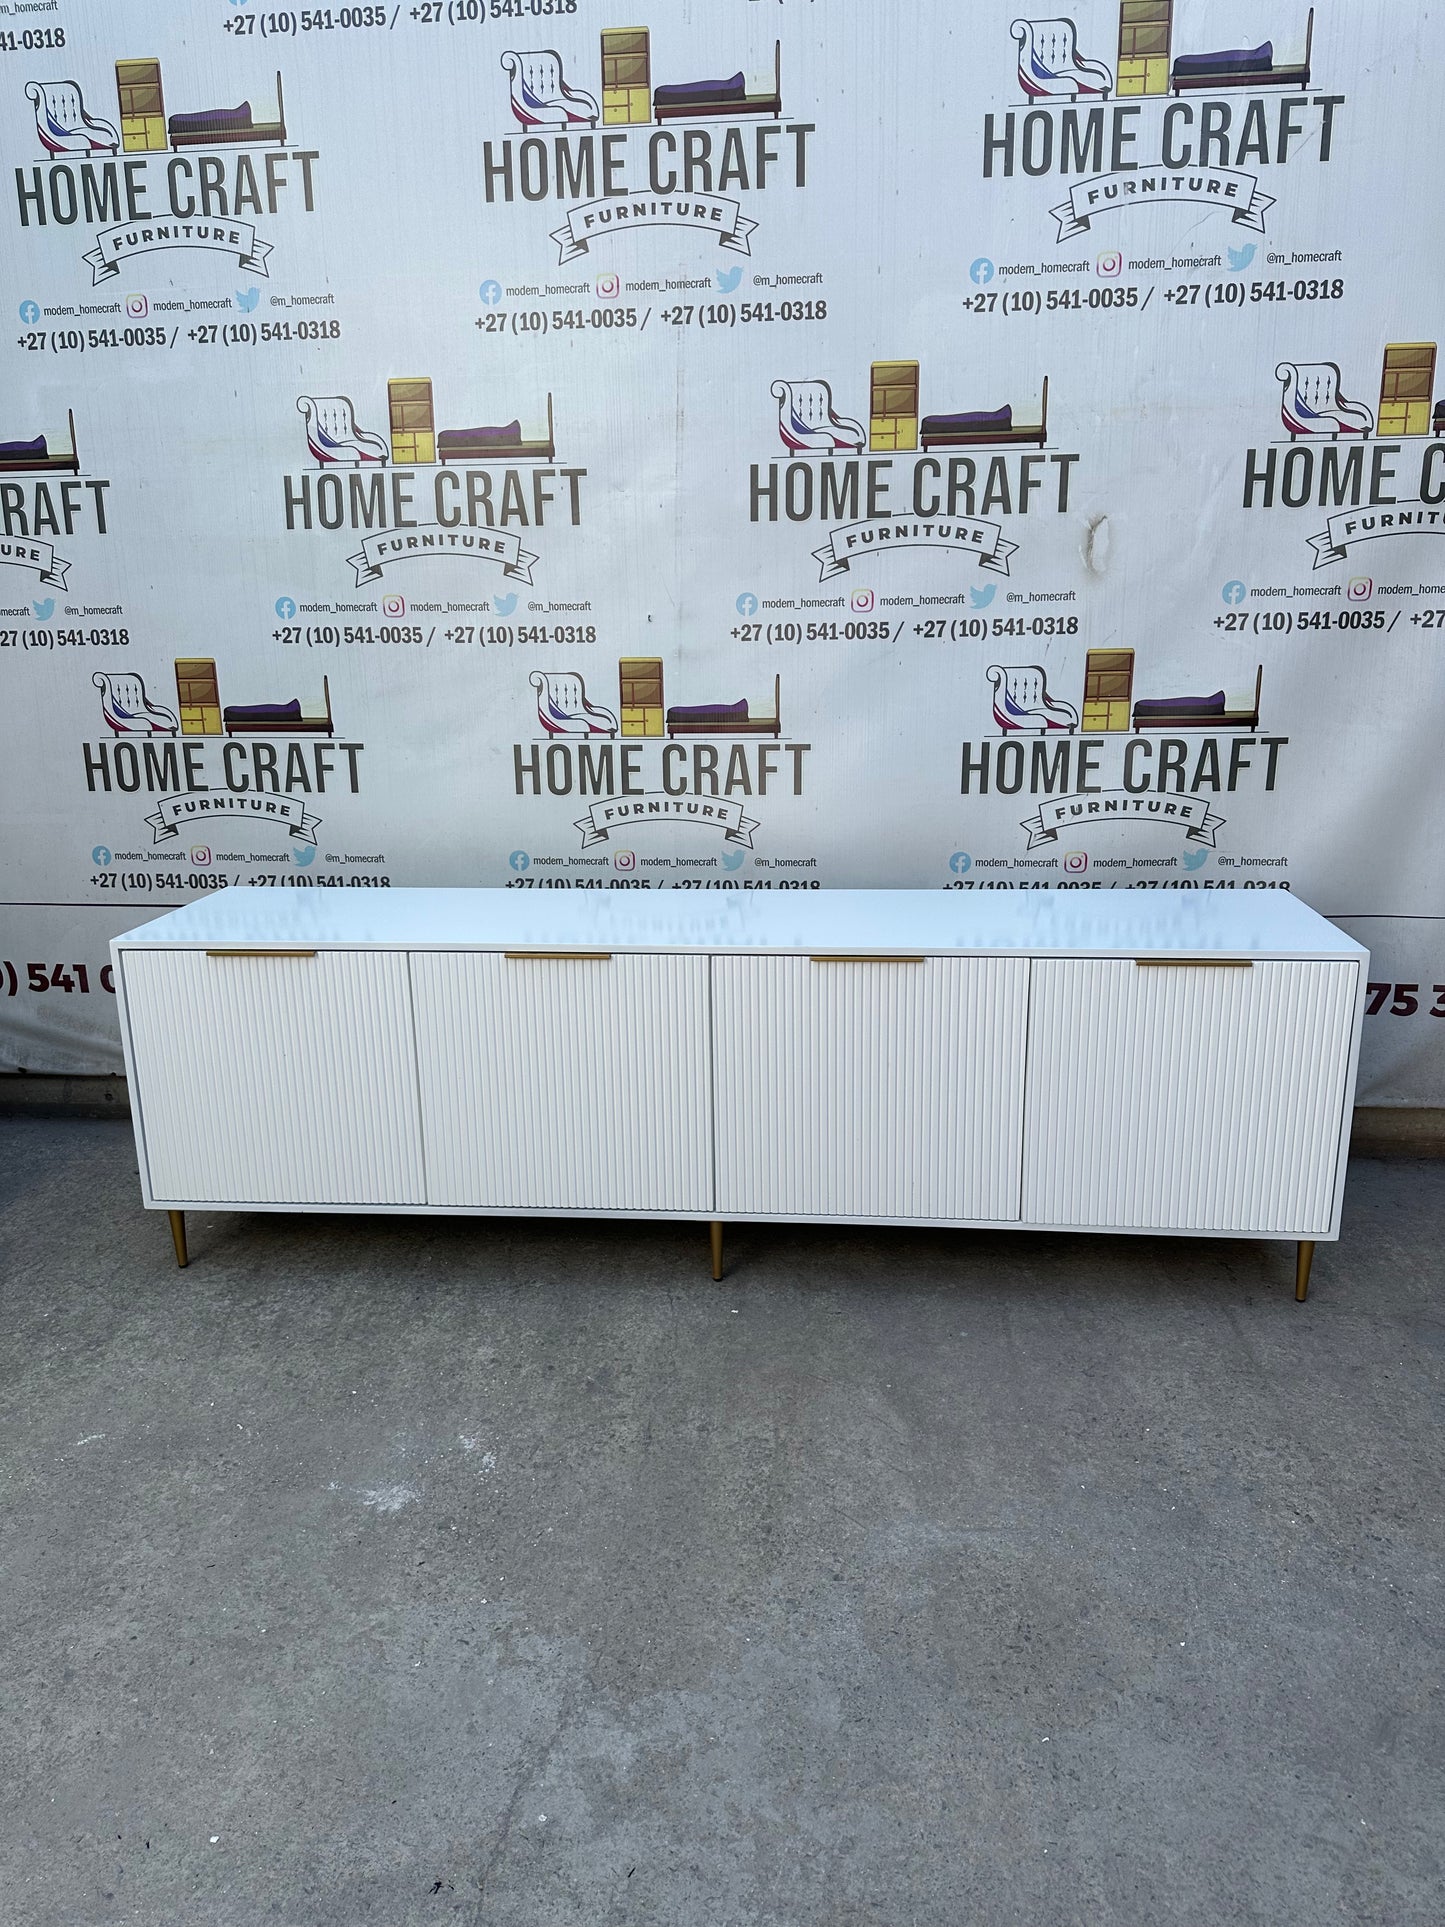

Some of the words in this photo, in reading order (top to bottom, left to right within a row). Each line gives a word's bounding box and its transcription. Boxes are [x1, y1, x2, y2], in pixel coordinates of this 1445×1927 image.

[0, 0, 58, 16] m_homecraft
[223, 14, 256, 35] +27
[260, 11, 297, 38] (10)
[301, 5, 386, 31] 541-0035
[389, 4, 401, 30] /
[409, 1, 443, 23] +27
[448, 0, 486, 26] (10)
[982, 105, 1141, 178] HOME
[1161, 95, 1346, 170] CRAFT
[483, 133, 629, 203] HOME
[648, 123, 816, 195] CRAFT
[14, 160, 152, 227] HOME
[167, 150, 320, 219] CRAFT
[1087, 177, 1239, 205] FURNITURE
[583, 202, 723, 229] FURNITURE
[112, 225, 240, 251] FURNITURE
[1266, 249, 1342, 266] @m_homecraft
[753, 272, 823, 288] @m_homecraft
[269, 293, 335, 308] @m_homecraft
[962, 292, 998, 313] +27
[1002, 291, 1042, 316] (10)
[1046, 287, 1138, 310] 541-0035
[1140, 286, 1155, 311] /
[1163, 284, 1201, 305] +27
[1205, 282, 1246, 309] (10)
[1249, 278, 1344, 302] 541-0318
[474, 313, 507, 333] +27
[511, 311, 548, 336] (10)
[552, 308, 637, 330] 541-0035
[640, 307, 652, 331] /
[660, 305, 694, 325] +27
[698, 304, 736, 329] (10)
[740, 300, 827, 323] 541-0318
[17, 332, 47, 351] +27
[51, 330, 85, 354] (10)
[88, 327, 166, 348] 541-0035
[169, 326, 179, 349] /
[187, 325, 218, 344] +27
[222, 323, 257, 347] (10)
[261, 320, 341, 342] 541-0318
[750, 459, 893, 522] HOME
[912, 453, 1080, 518] CRAFT
[1242, 444, 1401, 508] HOME
[283, 472, 418, 530] HOME
[434, 468, 588, 528] CRAFT
[1345, 511, 1445, 535] FURNIT
[377, 534, 506, 556] FURNITURE
[846, 524, 984, 549] FURNITURE
[527, 600, 592, 613] @m_homecraft
[1006, 590, 1076, 604] @m_homecraft
[0, 606, 31, 617] mecraft
[64, 604, 123, 616] @m_homecraft
[1213, 612, 1249, 631] +27
[1253, 612, 1293, 635] (10)
[1297, 610, 1385, 630] 541-0035
[1386, 610, 1402, 633] /
[22, 630, 54, 650] (10)
[57, 628, 130, 646] 541-0318
[272, 627, 302, 644] +27
[306, 626, 340, 648] (10)
[344, 626, 423, 644] 541-0035
[426, 626, 436, 648] /
[444, 626, 475, 644] +27
[479, 626, 514, 648] (10)
[517, 626, 596, 644] 541-0318
[730, 624, 763, 642] +27
[766, 623, 802, 645] (10)
[806, 621, 890, 641] 541-0035
[892, 621, 905, 643] /
[913, 620, 947, 638] +27
[950, 619, 988, 642] (10)
[991, 616, 1079, 637] 541-0318
[82, 741, 209, 793] HOME
[222, 741, 365, 794] CRAFT
[513, 743, 645, 796] HOME
[662, 743, 812, 797] CRAFT
[960, 739, 1105, 795] HOME
[1123, 737, 1289, 794] CRAFT
[172, 798, 291, 817] FURNITURE
[604, 801, 728, 820] FURNITURE
[1055, 799, 1193, 820] FURNITURE
[325, 853, 385, 865] @m_homecraft
[754, 857, 817, 869] @m_homecraft
[1217, 855, 1288, 868] @m_homecraft
[90, 872, 117, 888] +27
[121, 873, 153, 892] (10)
[155, 873, 229, 889] 541-0035
[743, 880, 820, 890] 5410318
[27, 963, 90, 994] 541
[1365, 982, 1419, 1017] 75
